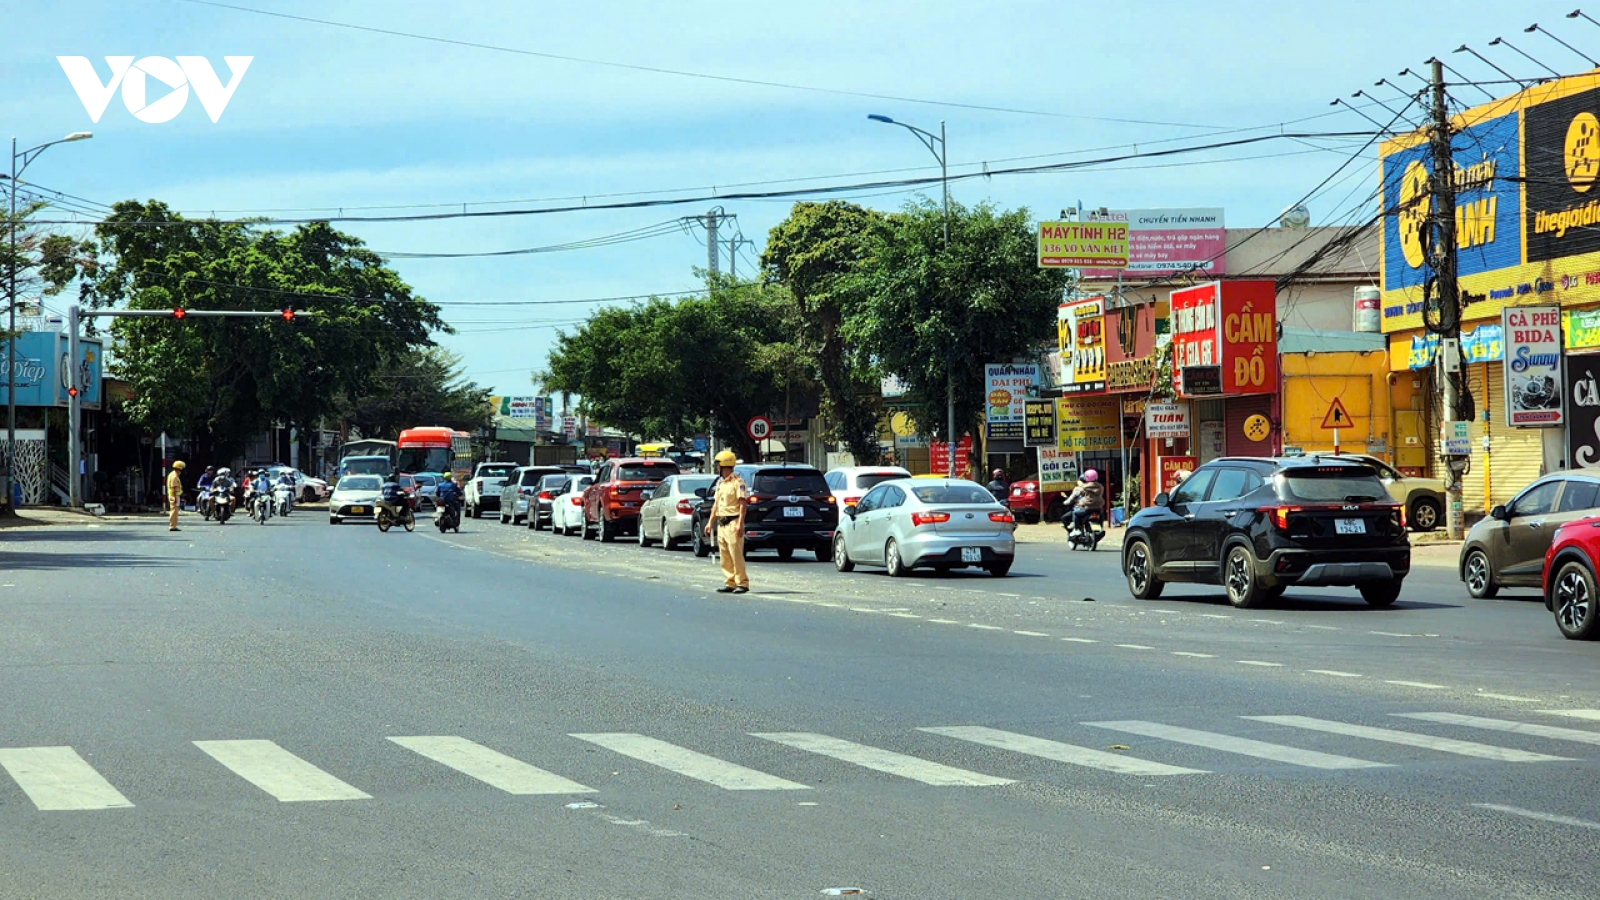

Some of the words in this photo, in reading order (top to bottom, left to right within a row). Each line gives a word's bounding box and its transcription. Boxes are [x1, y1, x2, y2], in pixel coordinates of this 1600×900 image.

[1108, 227, 1126, 240] H2
[1568, 276, 1578, 288] LG
[1224, 300, 1272, 344] CẦM
[1508, 310, 1528, 328] CÀ
[1532, 309, 1560, 326] PHÊ
[1513, 330, 1556, 344] BIDA
[1234, 344, 1266, 387] ĐỒ
[1510, 346, 1561, 373] Sunny
[754, 423, 766, 435] 60
